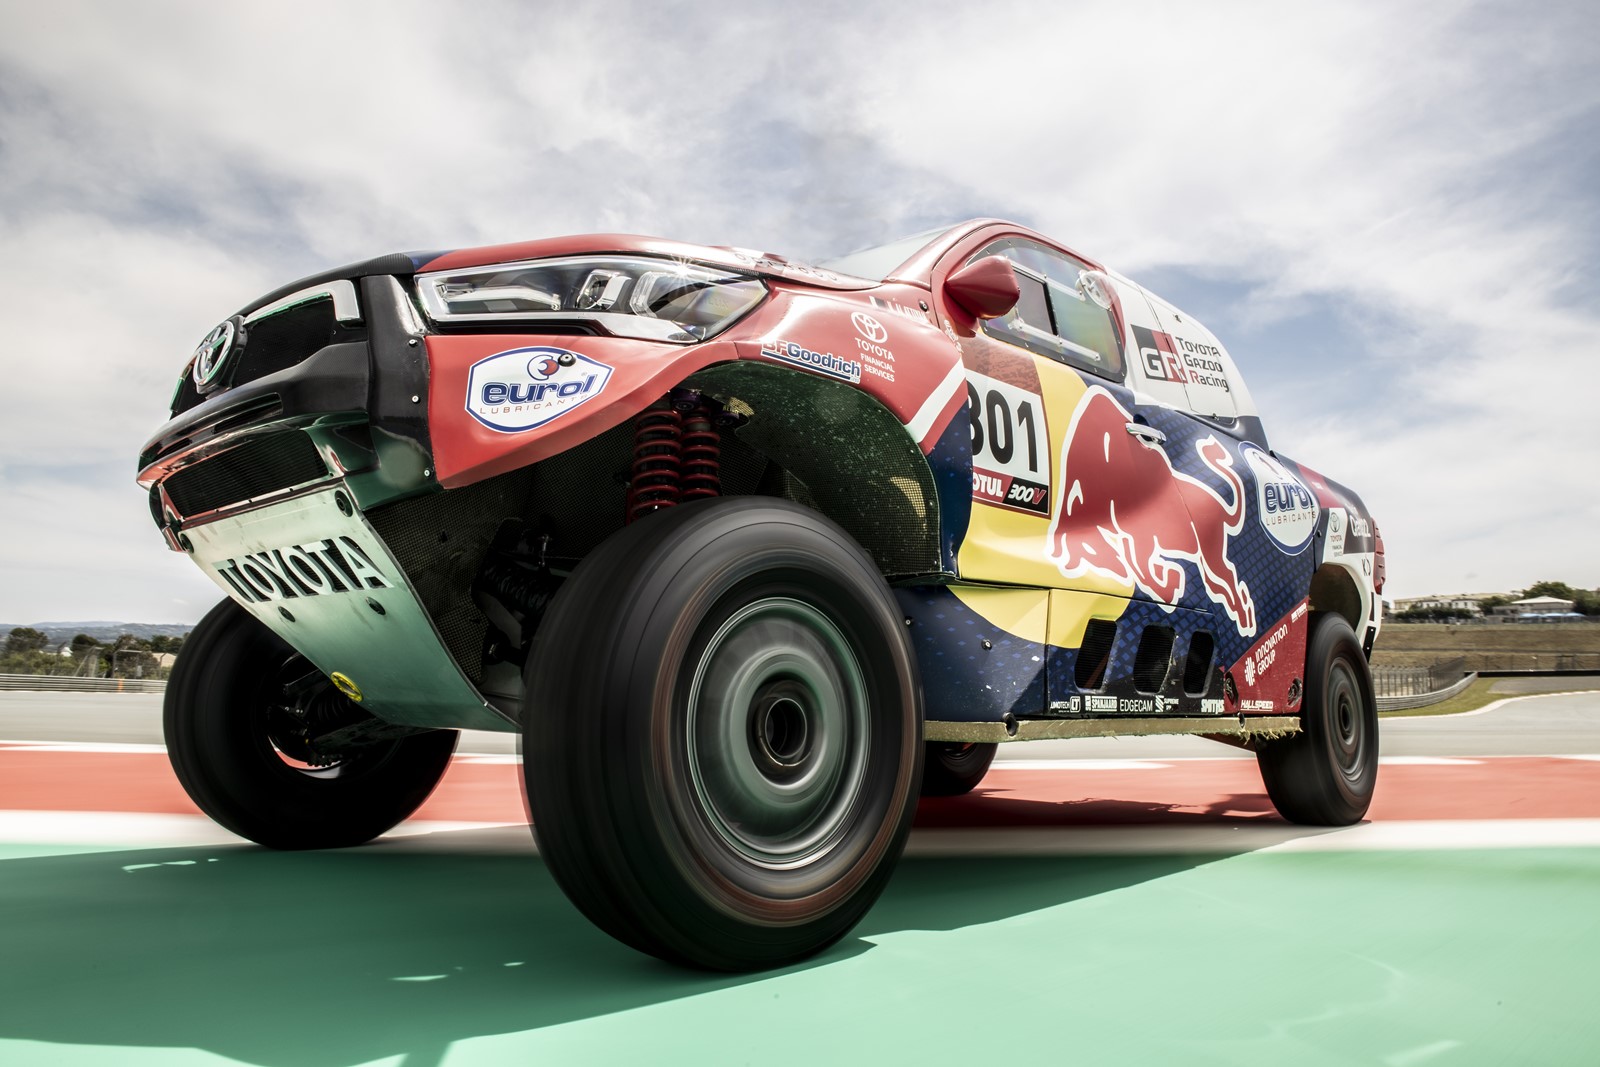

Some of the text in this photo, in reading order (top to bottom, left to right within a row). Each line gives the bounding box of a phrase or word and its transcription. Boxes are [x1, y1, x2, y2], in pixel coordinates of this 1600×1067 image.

[761, 339, 861, 378] BFGoodrich
[854, 337, 896, 362] TOYOTA
[1175, 336, 1221, 358] TOYOTA
[860, 352, 896, 373] FINANCIAL
[863, 363, 896, 383] SERVICES
[1140, 346, 1188, 382] GR
[1183, 353, 1223, 373] GAZOO
[481, 373, 599, 406] eurol
[1188, 369, 1230, 393] Racing
[479, 394, 588, 415] LUBRICANTS
[972, 472, 1047, 505] OTUL 300V
[1265, 510, 1316, 526] LUBRICANTS
[211, 535, 395, 604] TOYOTA
[1257, 649, 1276, 675] GROUP
[1120, 699, 1153, 712] EDGECAM
